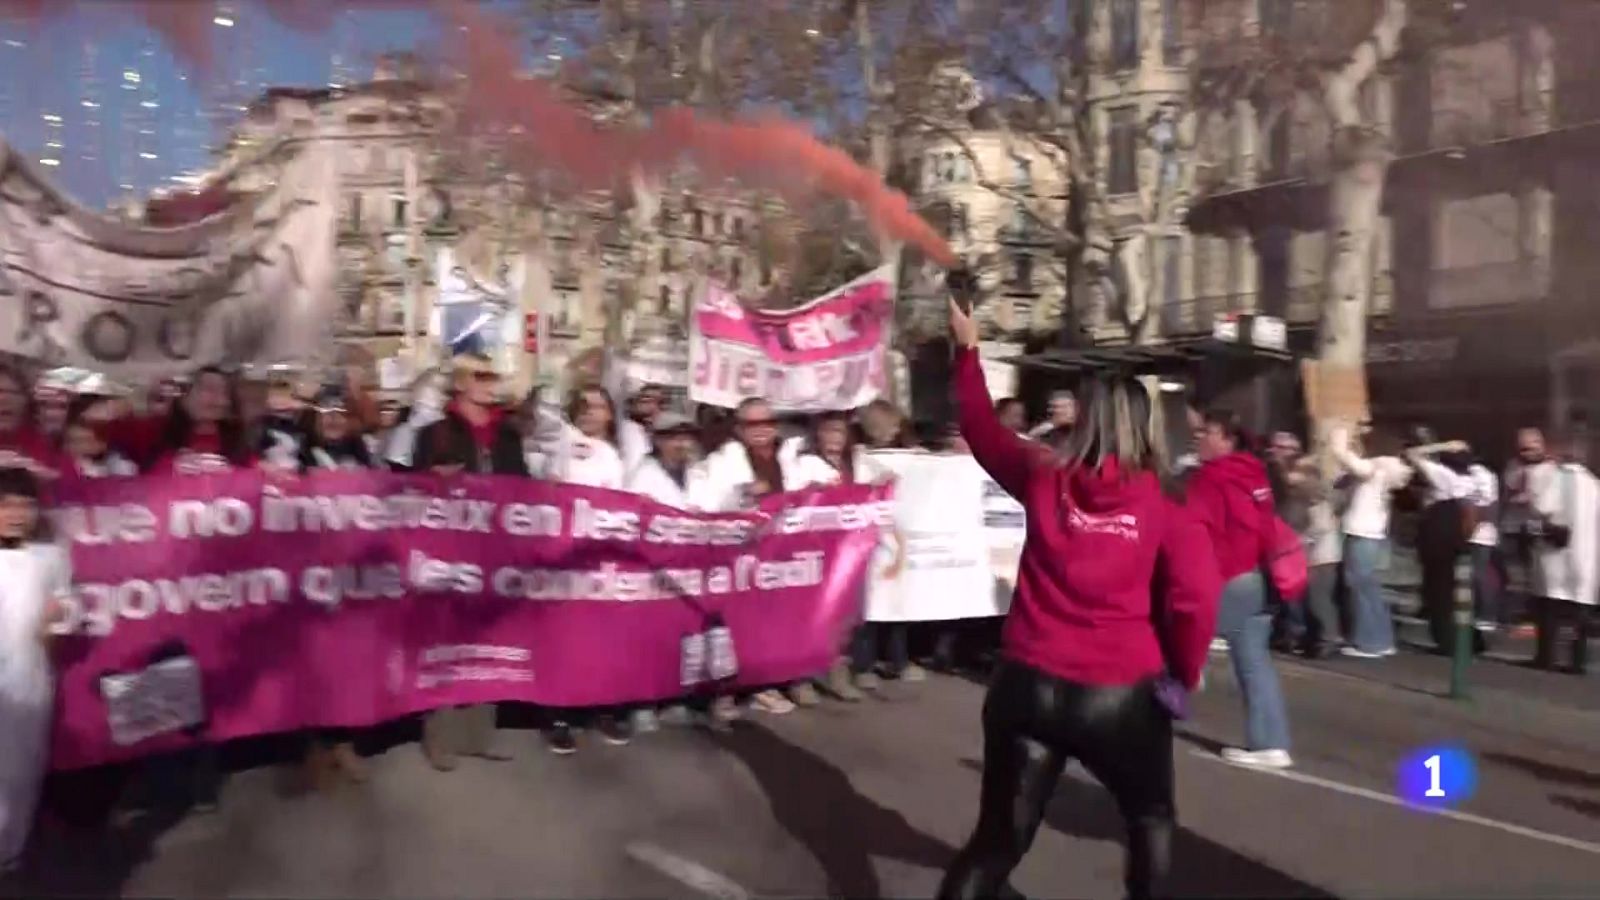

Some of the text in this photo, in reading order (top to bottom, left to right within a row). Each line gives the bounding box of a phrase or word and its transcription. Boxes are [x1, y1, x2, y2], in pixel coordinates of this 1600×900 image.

[168, 497, 254, 538] no
[501, 502, 563, 537] en
[571, 497, 641, 541] les
[302, 563, 407, 613] que
[408, 548, 485, 595] les
[708, 565, 732, 594] a
